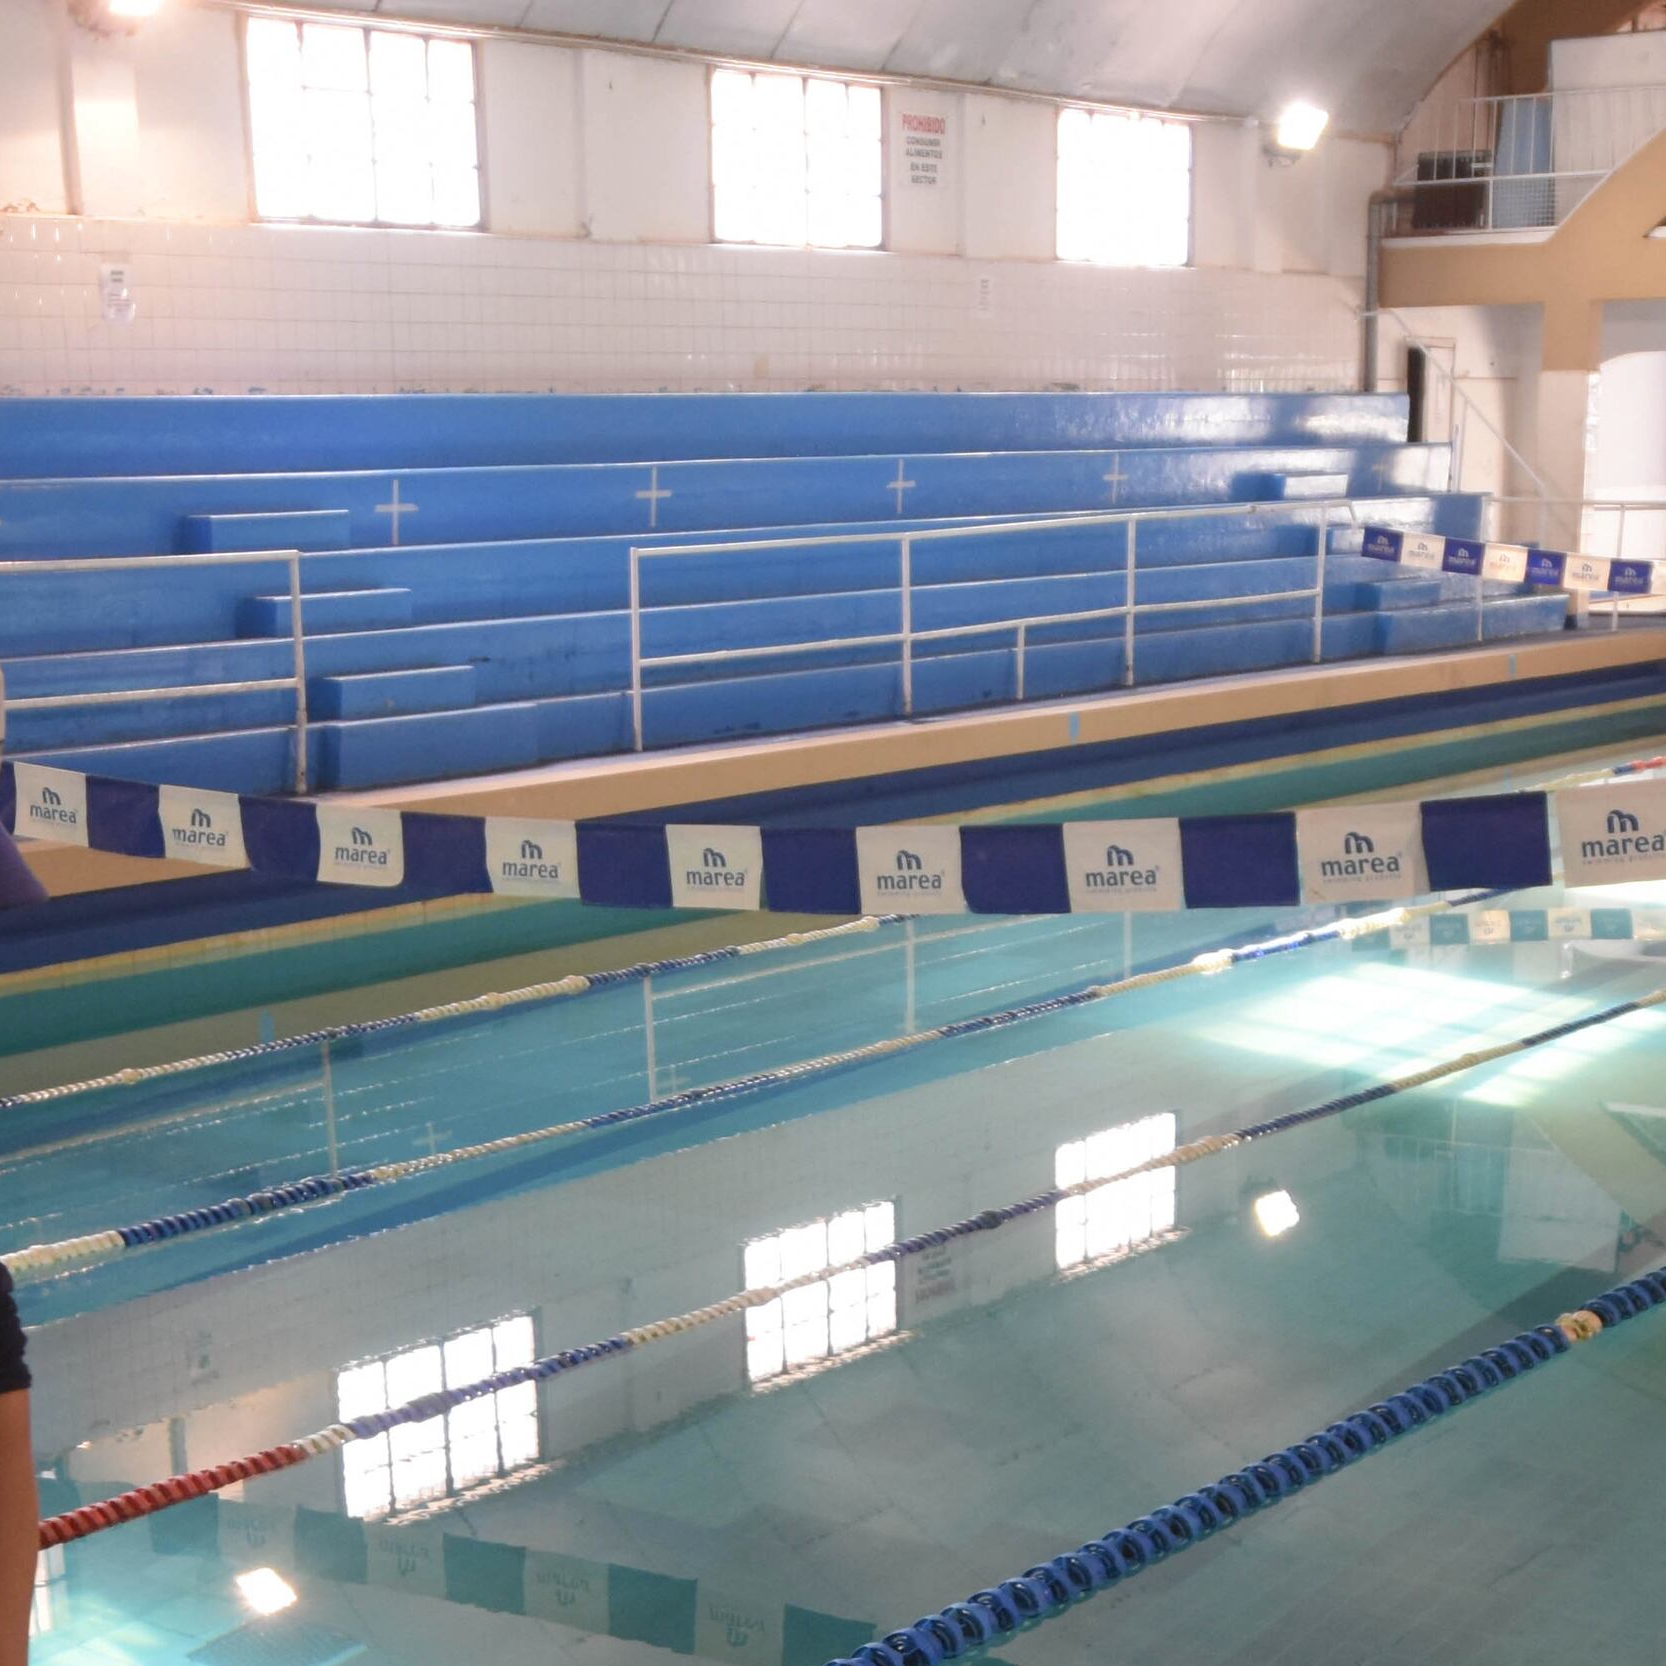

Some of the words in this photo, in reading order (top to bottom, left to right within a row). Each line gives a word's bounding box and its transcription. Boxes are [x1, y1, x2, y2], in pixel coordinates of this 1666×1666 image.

[902, 113, 946, 135] PROHIBIDO
[30, 804, 77, 824] marea
[173, 828, 226, 847] marea
[1581, 833, 1665, 858] marea
[335, 847, 387, 866] marea
[503, 861, 559, 879] marea
[1321, 857, 1400, 879] marea
[686, 869, 745, 887] marea
[877, 872, 941, 891] marea
[1086, 868, 1157, 888] marea
